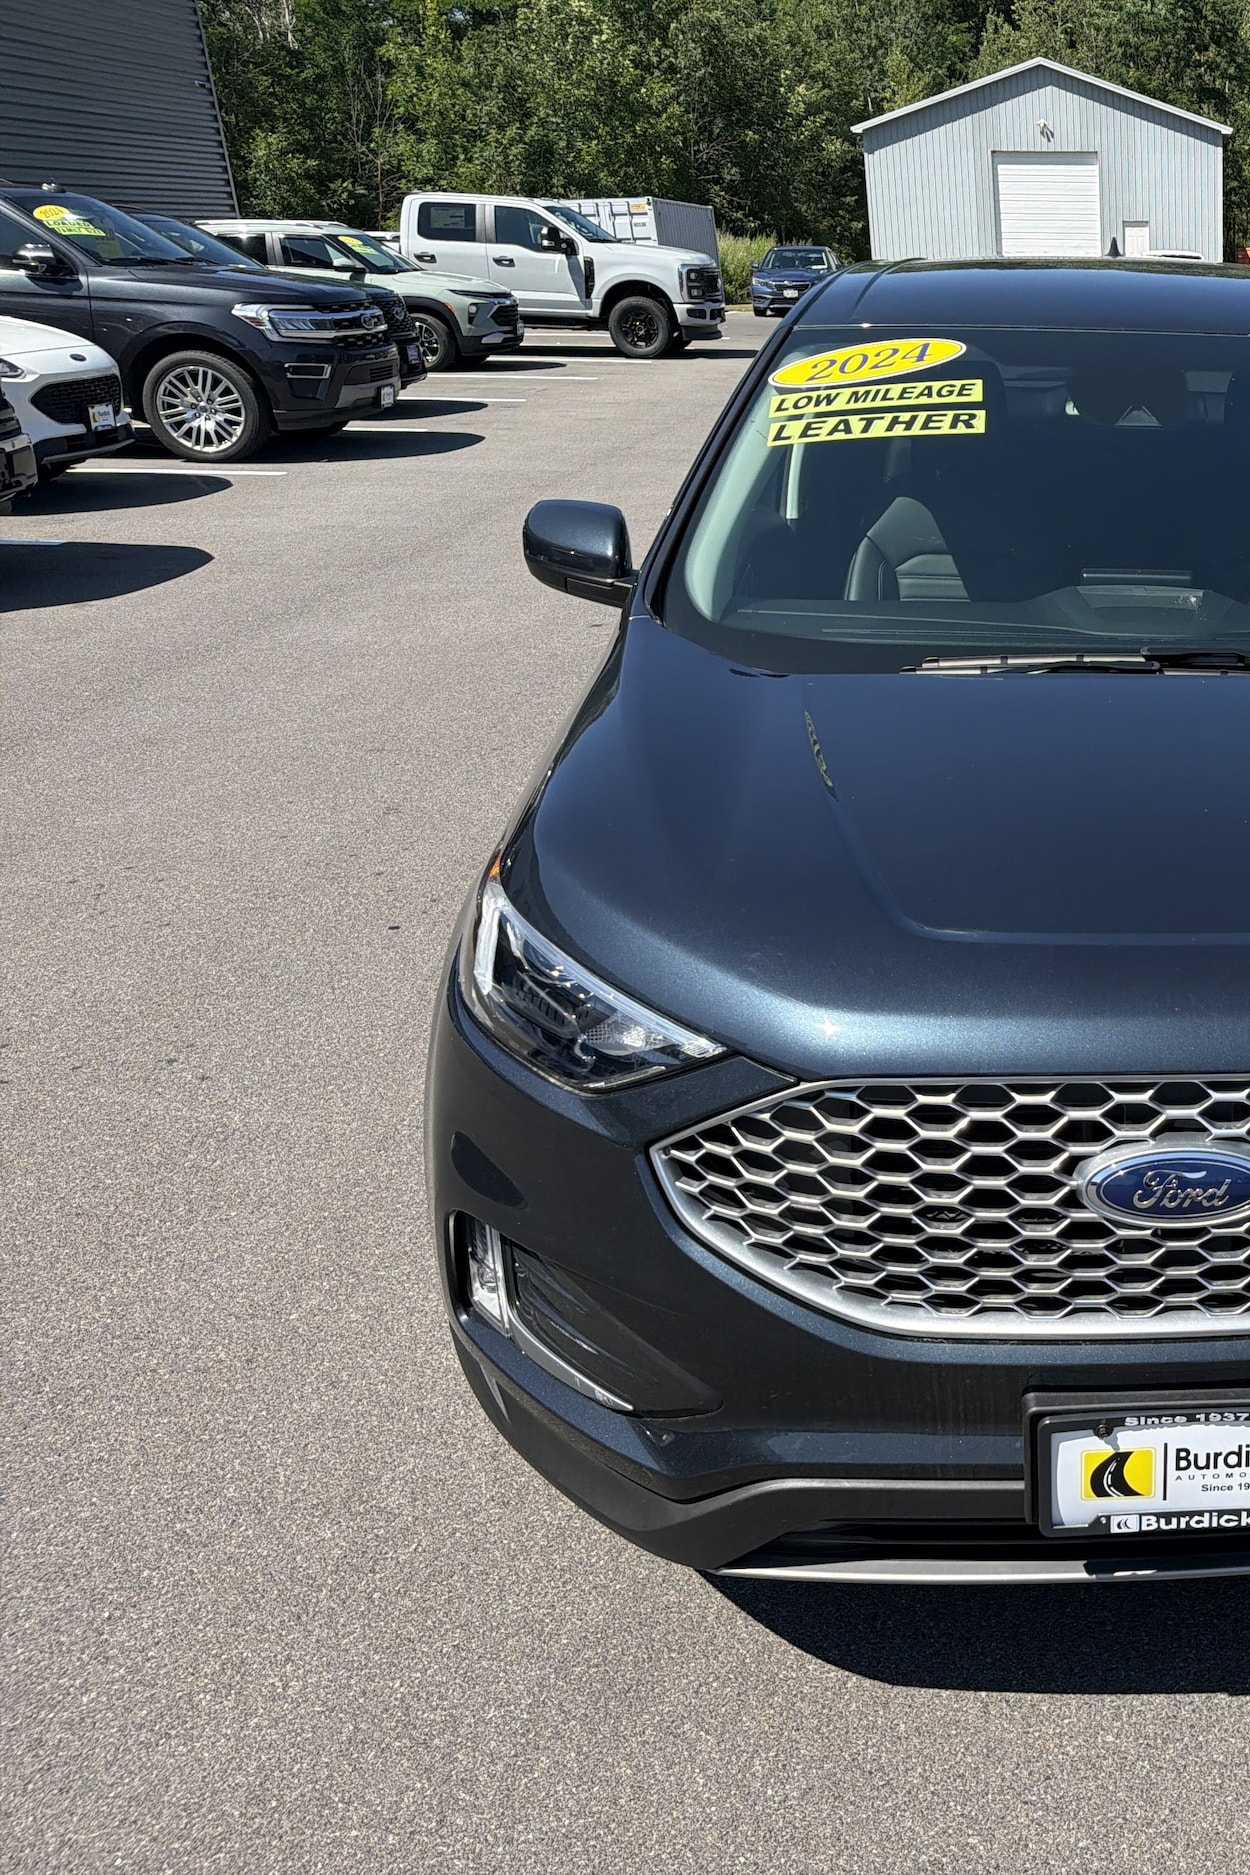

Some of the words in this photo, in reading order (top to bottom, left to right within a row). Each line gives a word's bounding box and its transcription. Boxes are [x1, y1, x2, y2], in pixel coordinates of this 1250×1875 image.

[804, 343, 933, 382] 2024
[774, 392, 841, 413] LOW
[845, 383, 977, 406] MILEAGE
[771, 413, 979, 442] LEATHER
[1133, 1169, 1232, 1208] Ford
[1125, 1415, 1187, 1426] Since
[1196, 1412, 1250, 1423] 1937
[1201, 1483, 1234, 1492] Since
